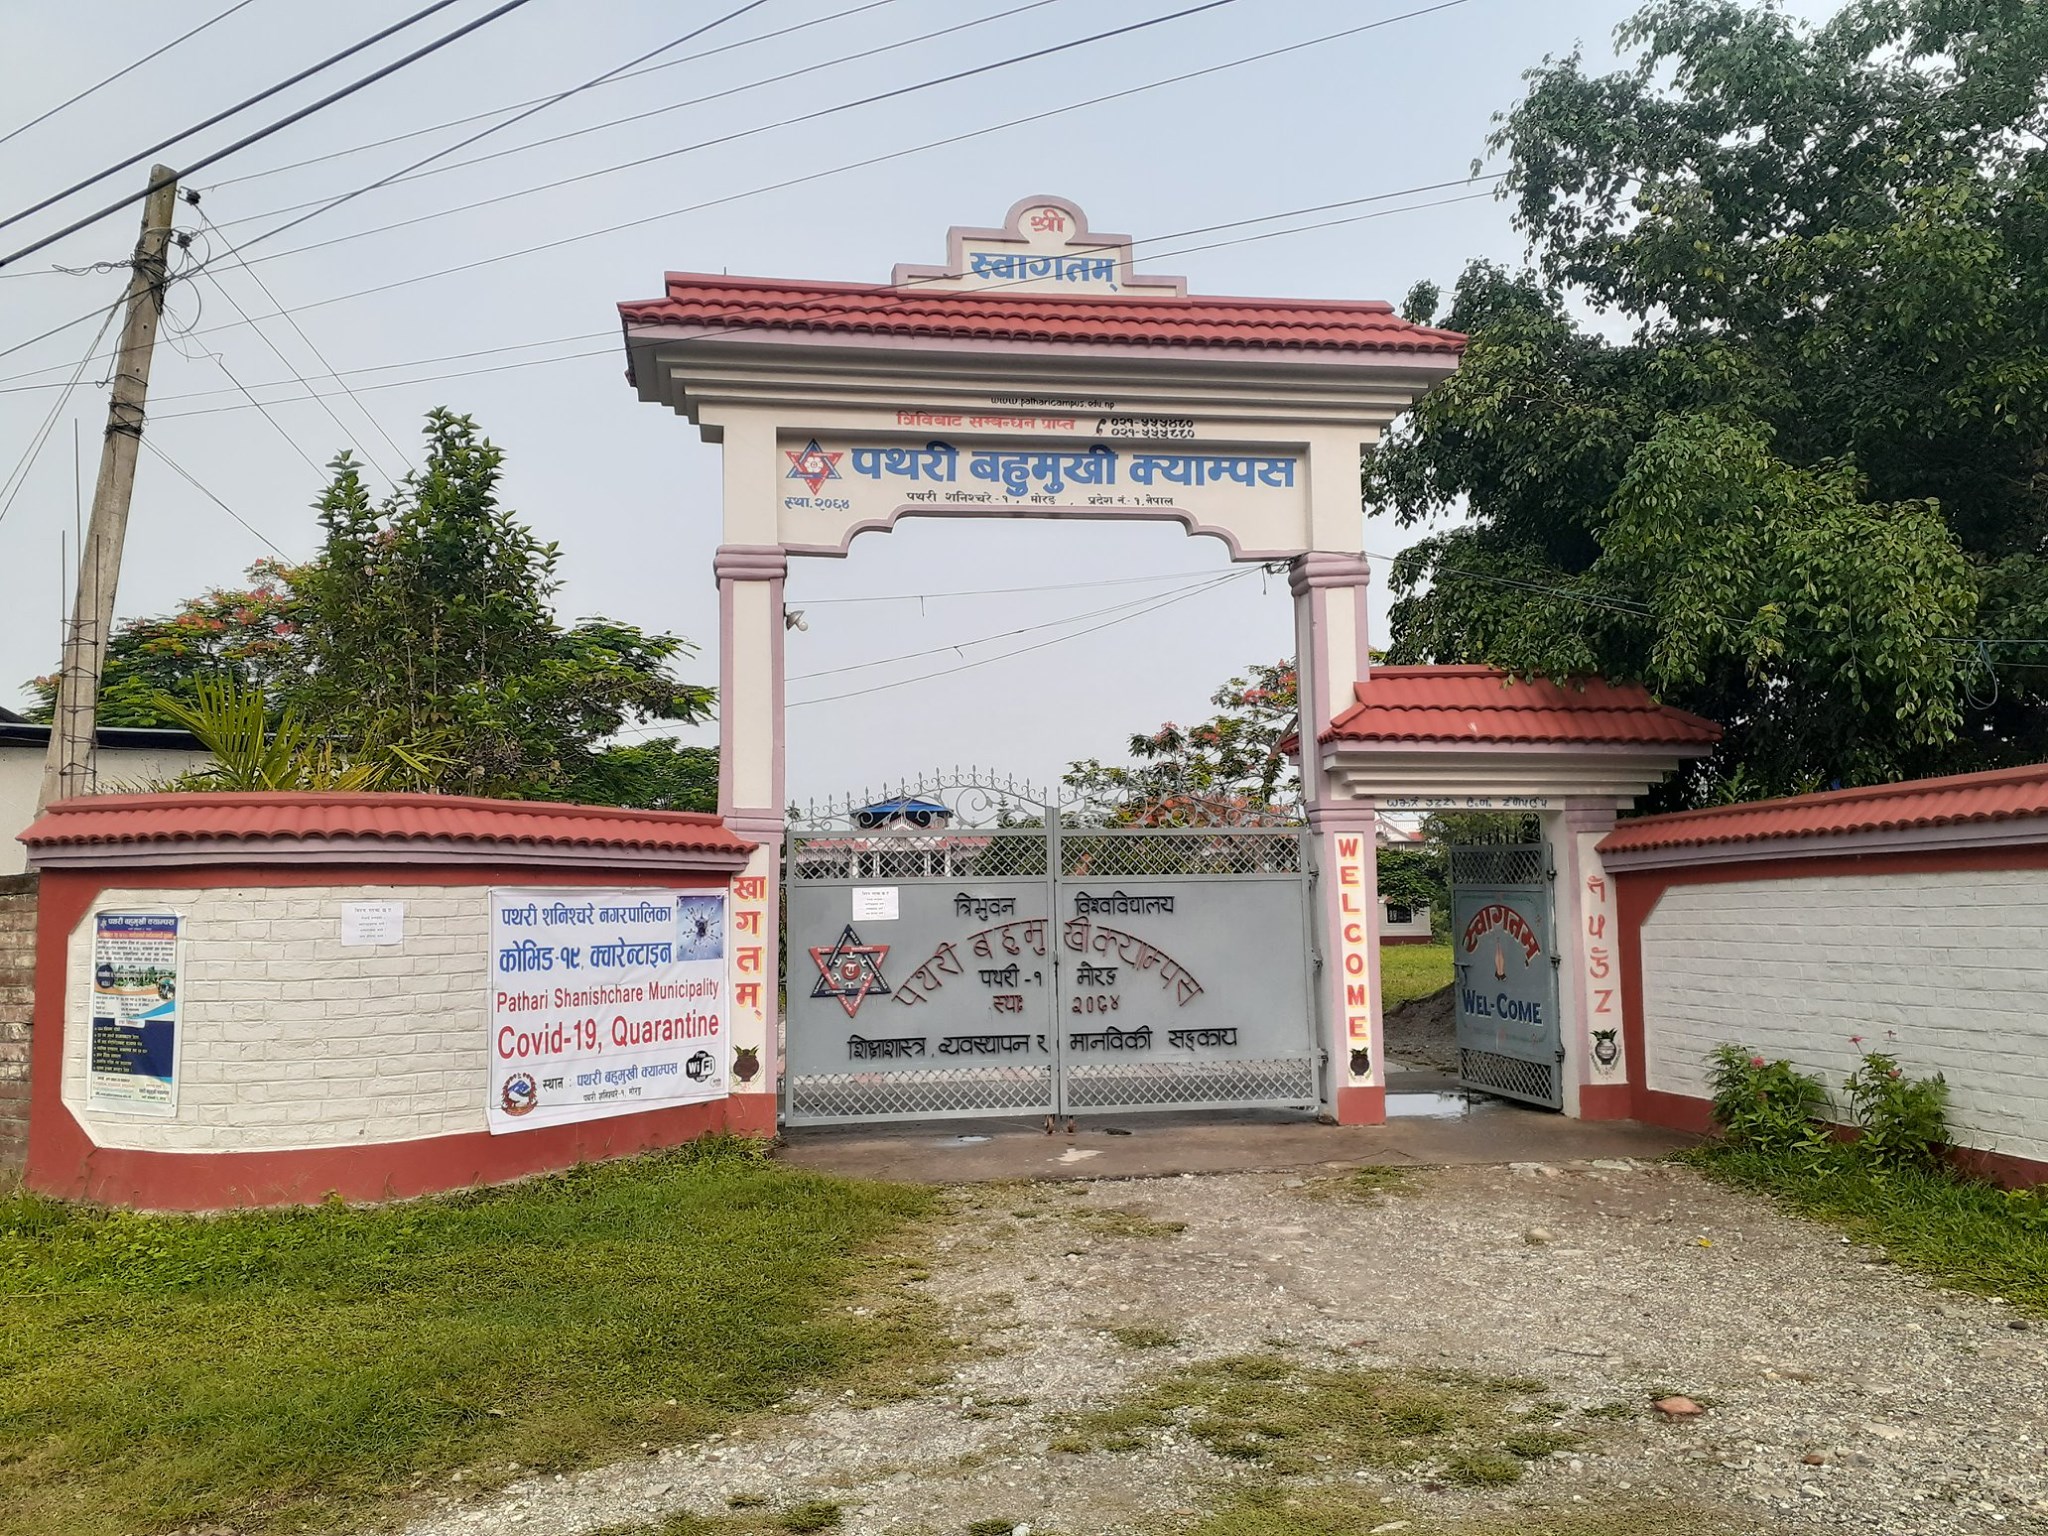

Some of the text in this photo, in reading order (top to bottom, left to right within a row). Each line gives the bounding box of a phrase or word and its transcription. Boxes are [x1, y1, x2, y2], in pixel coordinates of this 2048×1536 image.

[1030, 209, 1065, 232] श्री
[970, 252, 1117, 292] स्वागतम्
[1041, 418, 1075, 431] प्राप्त
[851, 441, 959, 482] पथरी
[970, 444, 1119, 496] बहुमुखी
[1129, 454, 1297, 488] क्याम्पस
[906, 490, 937, 502] पथरी
[1088, 493, 1113, 505] प्रदेश
[501, 901, 672, 926] पथरी शनिश्चरे नगरपालिका
[953, 890, 1175, 921] त्रिभुवन विश्वविद्यालय
[1338, 838, 1367, 1039] WELCOME
[1462, 904, 1541, 969] स्वागतम्
[590, 937, 672, 969] क्वारेन्टाइन
[891, 942, 963, 1005] पथरी
[978, 963, 1020, 987] पथरी
[496, 978, 719, 1013] Pathari Shanishchare Municipality
[1072, 995, 1120, 1014] २०६४
[498, 1009, 719, 1059] Covid-19, Quarantine
[938, 1034, 1030, 1056] व्यवस्थापन
[1037, 1034, 1049, 1053] र
[1070, 1025, 1153, 1051] मानविकी
[577, 1069, 602, 1087] पथरी
[605, 1065, 639, 1085] बहुमुखी
[641, 1062, 678, 1079] क्याम्पस
